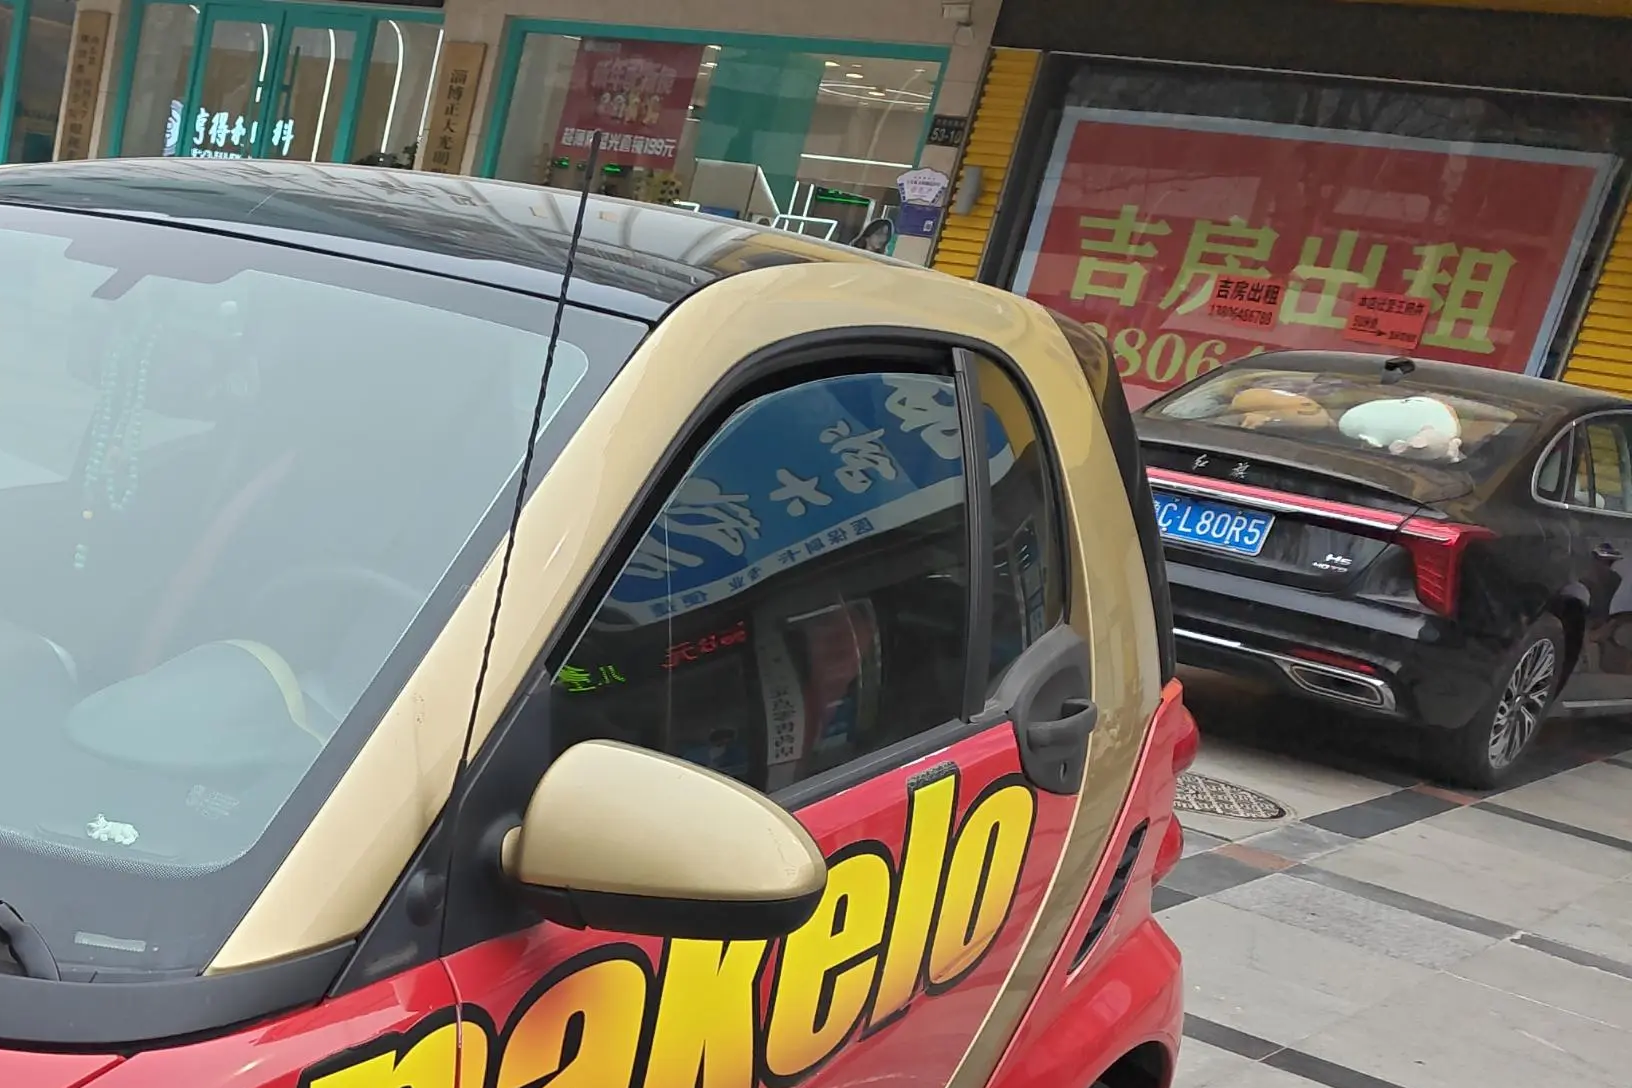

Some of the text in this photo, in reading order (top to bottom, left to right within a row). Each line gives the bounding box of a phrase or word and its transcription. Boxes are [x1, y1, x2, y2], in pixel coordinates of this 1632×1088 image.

[431, 69, 468, 172] 淄博正大光明
[1070, 204, 1518, 354] 吉房出租
[1216, 280, 1281, 305] 吉房出租
[1192, 454, 1250, 479] 红旗
